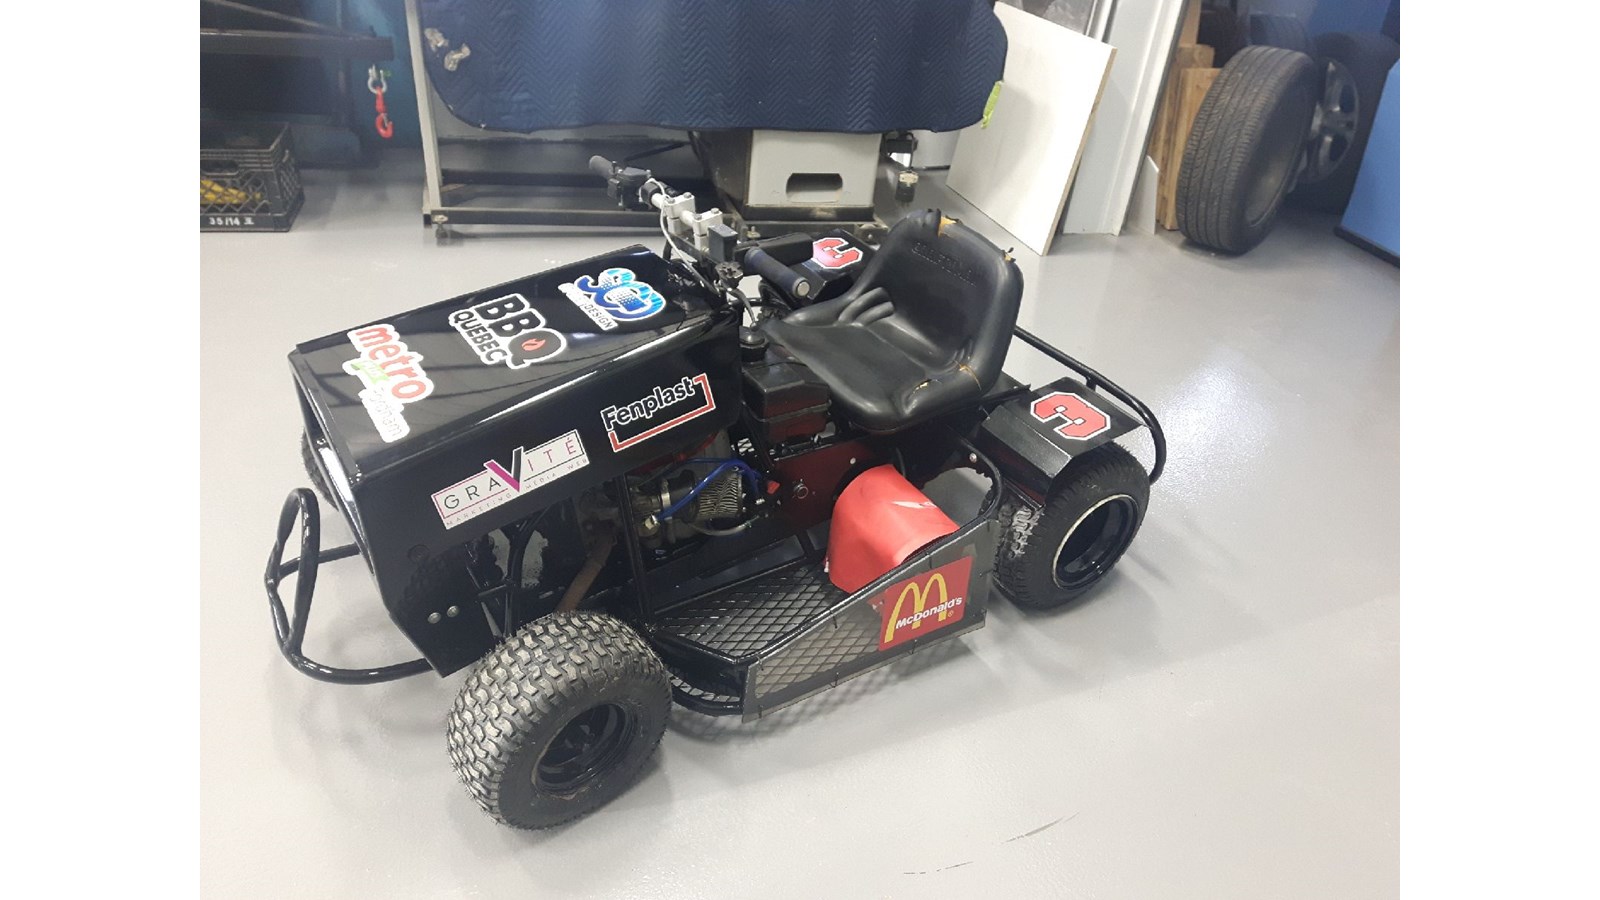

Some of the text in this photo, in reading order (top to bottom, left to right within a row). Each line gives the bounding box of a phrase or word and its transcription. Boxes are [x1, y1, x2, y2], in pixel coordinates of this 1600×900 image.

[453, 310, 508, 362] QUEBEC
[474, 294, 563, 367] BBQ
[583, 302, 615, 330] DESIGN
[354, 327, 427, 399] metro
[600, 376, 696, 432] Fenplast
[1030, 391, 1111, 441] 3
[444, 437, 577, 510] GRAVITÉ
[895, 597, 963, 630] McDonald's
